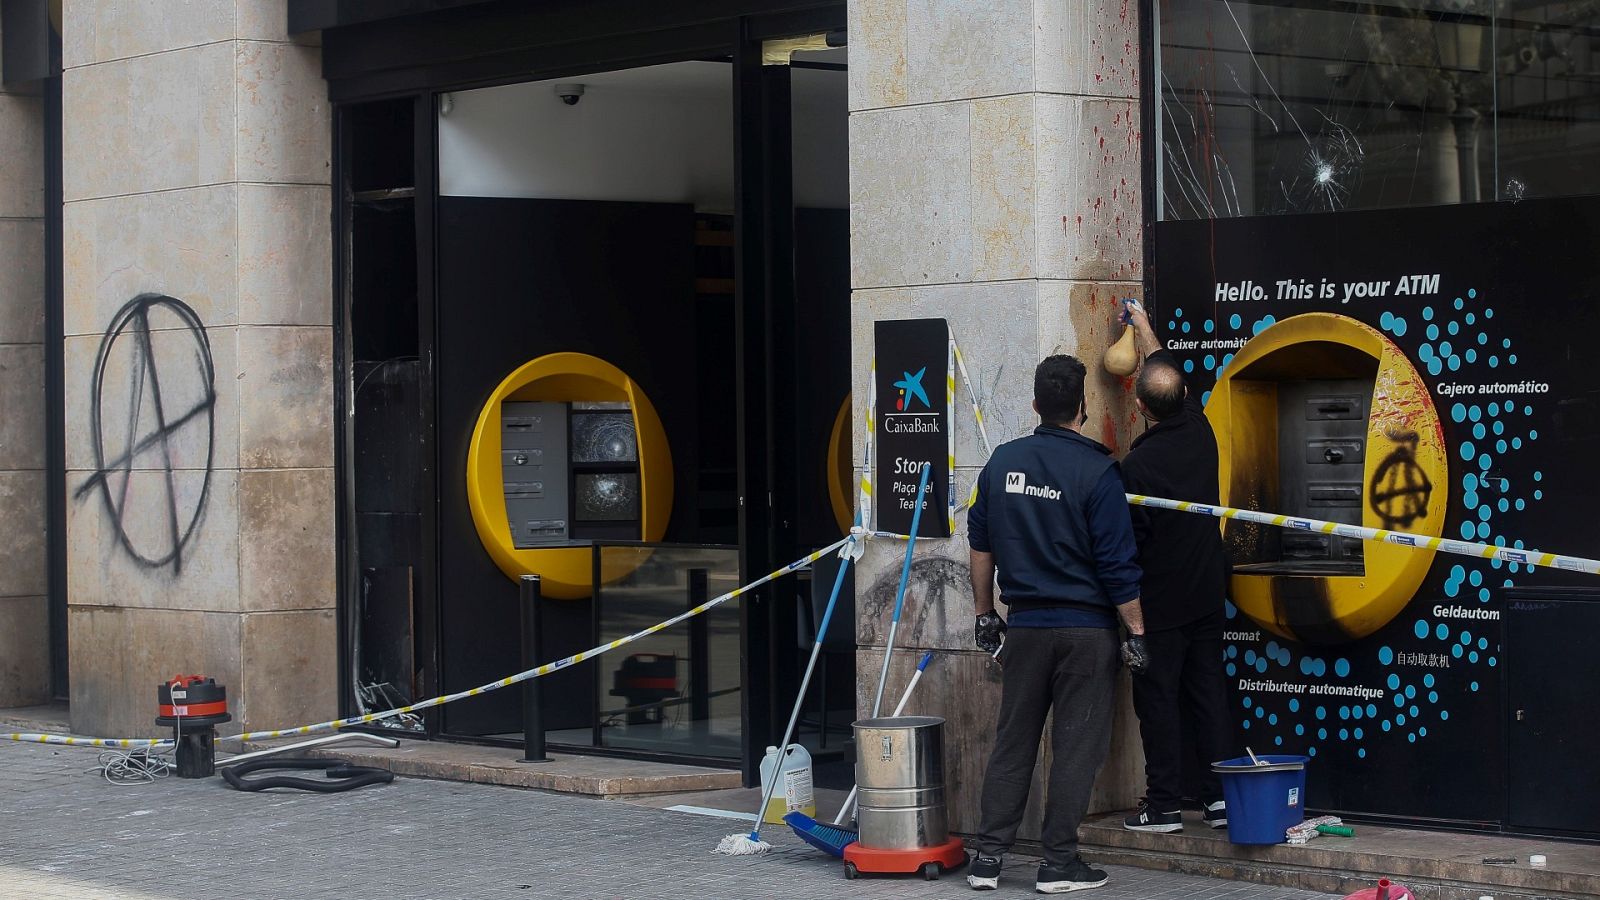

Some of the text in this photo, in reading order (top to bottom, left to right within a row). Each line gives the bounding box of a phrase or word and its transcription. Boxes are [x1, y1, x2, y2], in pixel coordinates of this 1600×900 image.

[1215, 273, 1441, 304] Hello. This is your ATM
[1167, 338, 1199, 350] Caixer
[1436, 380, 1550, 398] Cajero automático
[884, 416, 940, 433] CaixaBank
[892, 481, 916, 496] Plaça
[918, 481, 934, 493] el
[1008, 474, 1062, 500] M mullor
[899, 497, 928, 510] Teae
[1397, 650, 1450, 668] 自动取款机
[1238, 678, 1384, 700] Distributeur automatique
